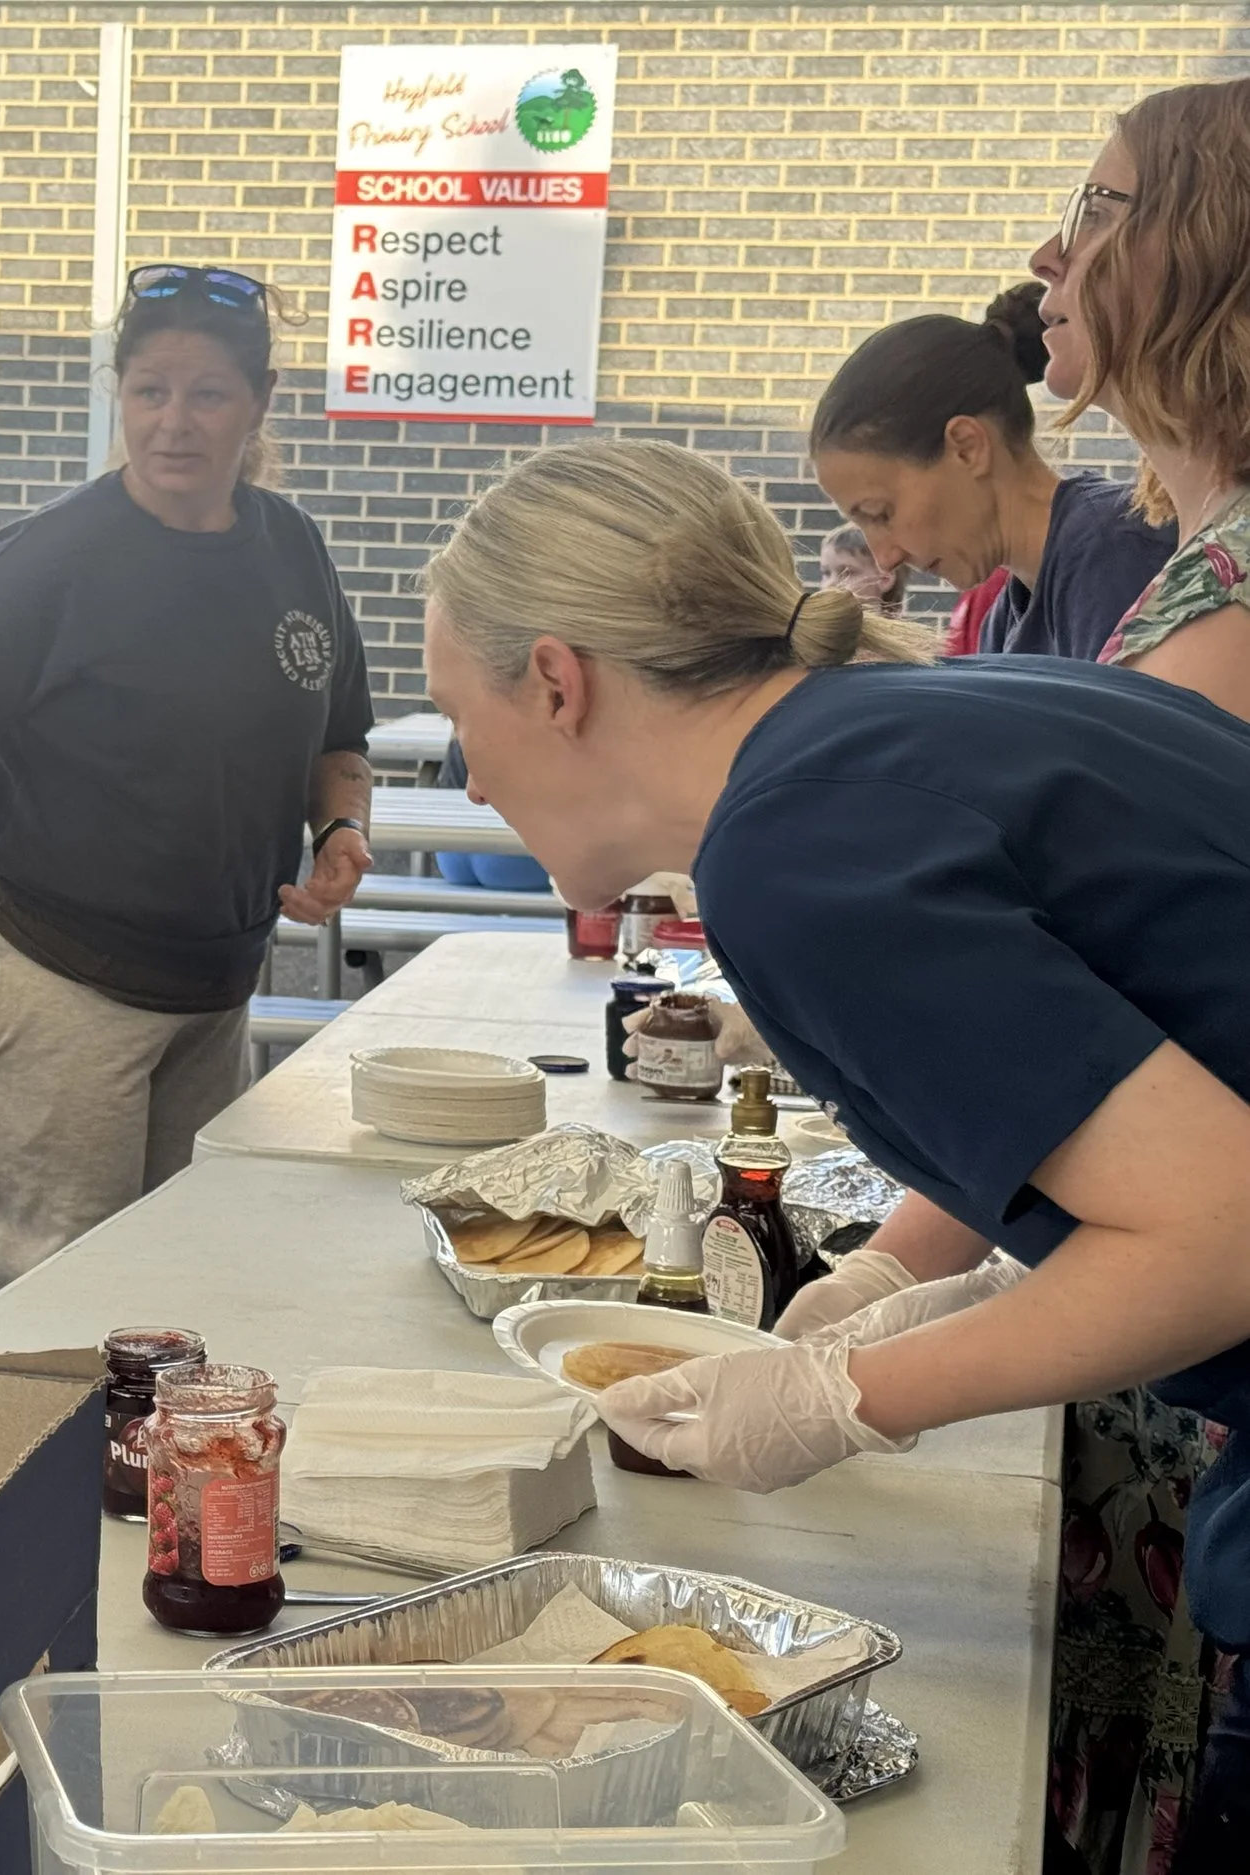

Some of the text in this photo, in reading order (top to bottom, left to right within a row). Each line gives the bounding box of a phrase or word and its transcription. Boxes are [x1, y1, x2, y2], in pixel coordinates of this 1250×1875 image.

[349, 107, 510, 157] Primary School
[357, 175, 584, 204] SCHOOL VALUES
[352, 224, 503, 262] Respect
[351, 271, 468, 309] Aspire
[347, 318, 532, 351] Resilience
[345, 365, 575, 402] Engagement
